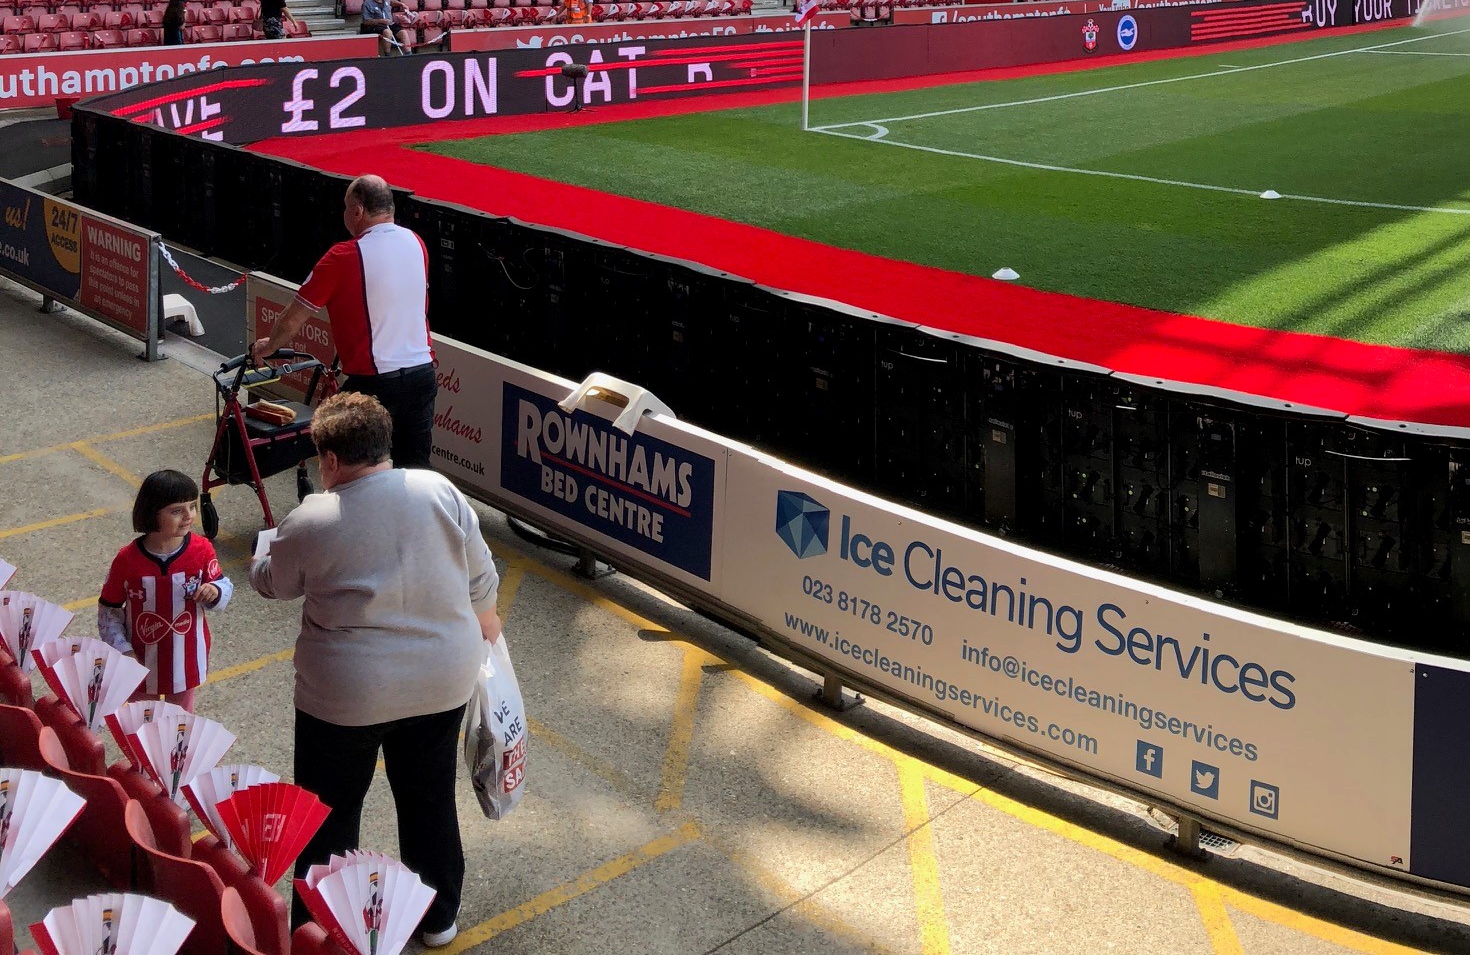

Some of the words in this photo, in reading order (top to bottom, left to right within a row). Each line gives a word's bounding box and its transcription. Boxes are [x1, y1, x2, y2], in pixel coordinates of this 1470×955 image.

[281, 65, 367, 133] £2
[421, 57, 498, 119] ON
[545, 45, 646, 107] CAT
[51, 204, 79, 235] 24/7
[51, 232, 79, 253] ACCESS
[87, 225, 142, 262] WARNING
[119, 275, 125, 286] to
[126, 280, 139, 293] pass
[130, 266, 139, 278] for
[102, 297, 133, 320] emergency
[436, 367, 462, 395] eds
[433, 405, 483, 444] nhams
[431, 443, 486, 477] centre.co.uk
[517, 398, 693, 508] ROWNHAMS
[541, 464, 579, 504] BED
[585, 485, 664, 544] CENTRE
[140, 617, 163, 639] Virgin
[802, 575, 834, 605] 023
[838, 584, 882, 626] 8178
[886, 609, 935, 647] 2570
[839, 514, 896, 577] Ice
[903, 540, 1083, 654] Cleaning
[1096, 602, 1297, 711] Services
[784, 611, 1099, 755] www.icecleaningservices.com
[961, 639, 1259, 763] info@icecleaningservices
[504, 715, 523, 748] ARE
